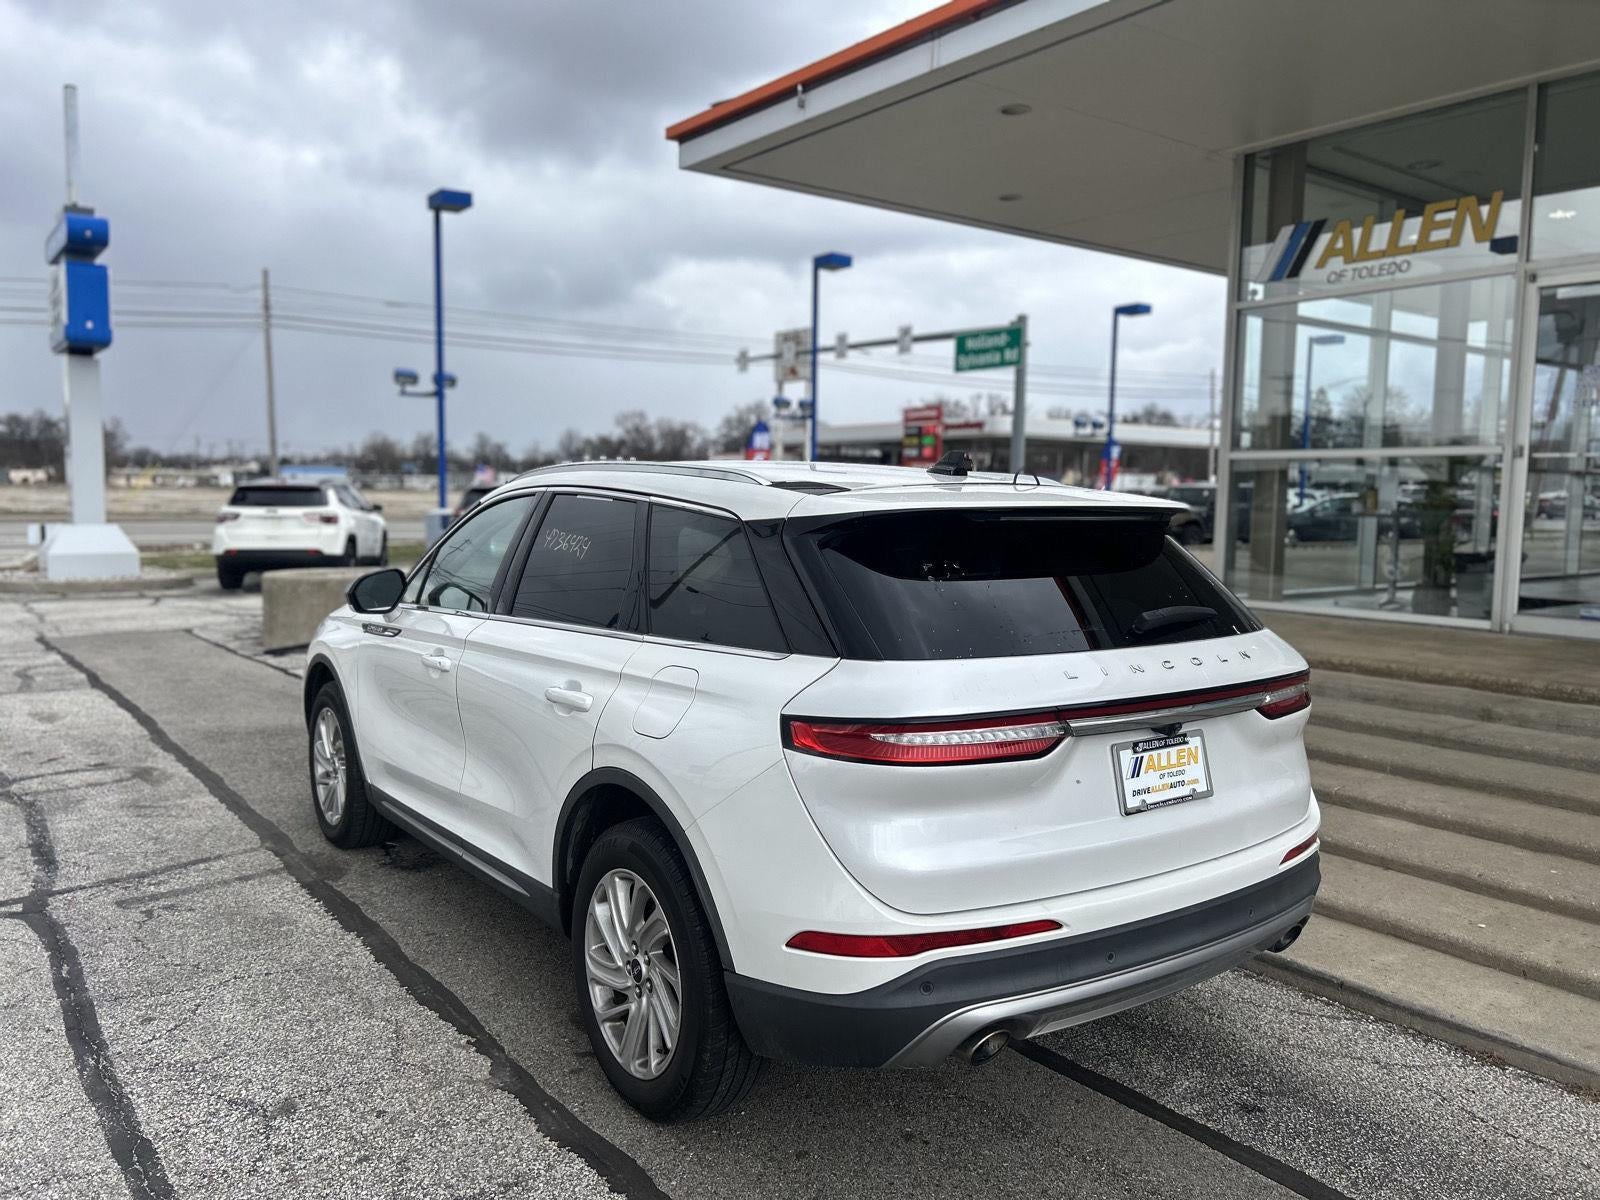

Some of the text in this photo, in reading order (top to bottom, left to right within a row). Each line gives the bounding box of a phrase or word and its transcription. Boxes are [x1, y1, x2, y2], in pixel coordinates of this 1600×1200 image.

[1314, 190, 1504, 269] ALLEN
[1327, 259, 1412, 284] OF TOLEDO
[1063, 650, 1251, 680] LINCOLN
[1143, 741, 1159, 750] ALLEN
[1166, 737, 1184, 746] TOLEDO
[1144, 746, 1199, 774] ALLEN
[1167, 769, 1185, 778] TOLEDO
